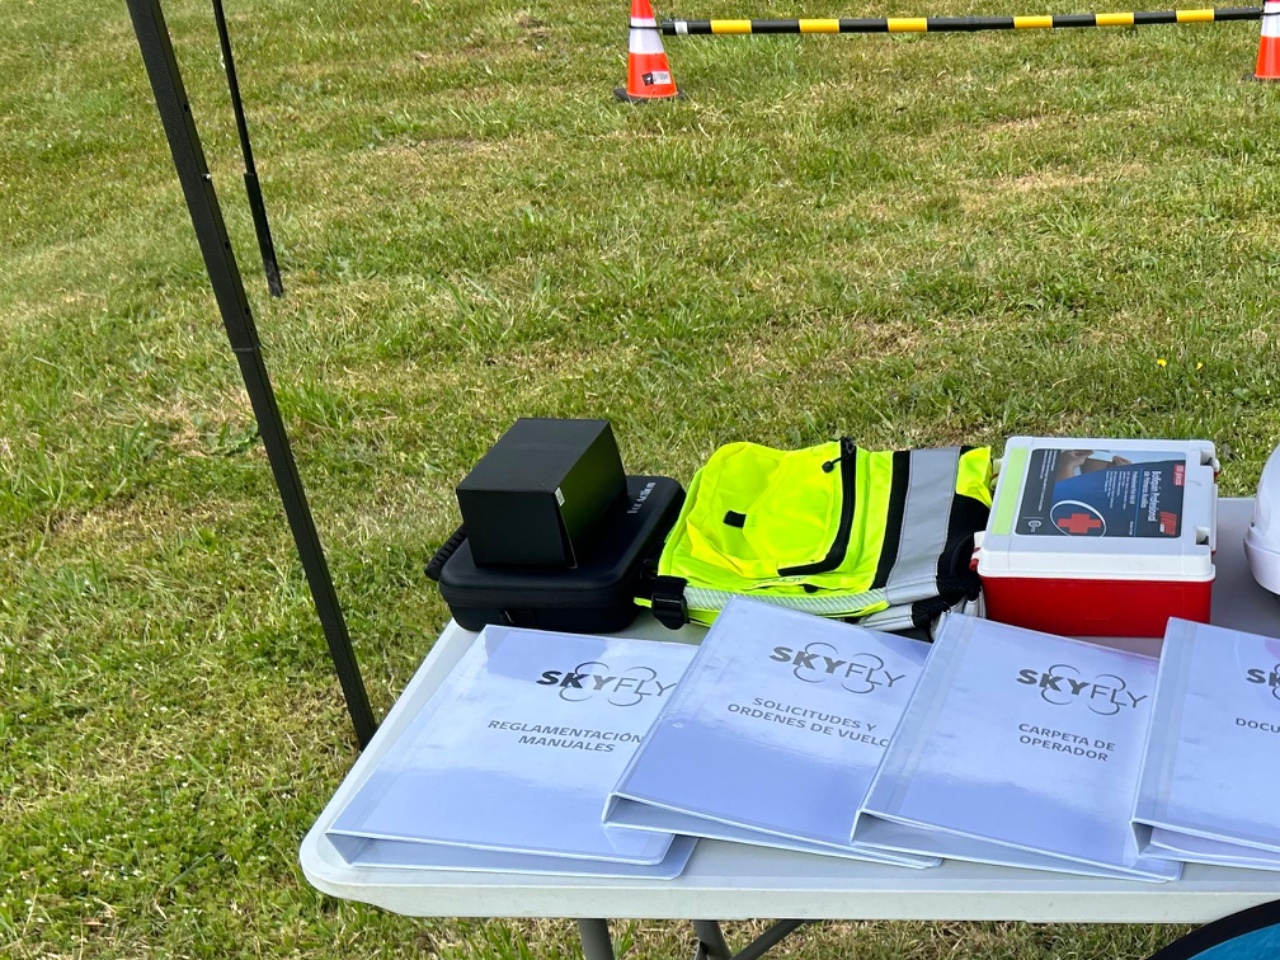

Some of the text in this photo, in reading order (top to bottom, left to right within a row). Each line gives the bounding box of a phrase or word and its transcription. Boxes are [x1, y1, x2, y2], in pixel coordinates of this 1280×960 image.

[769, 645, 906, 688] SKYFLY
[536, 669, 677, 698] SKYFLY
[1016, 668, 1148, 709] SKYFLY
[727, 703, 806, 729] ORDENES
[810, 722, 833, 736] DE
[752, 697, 878, 732] SOLICITUDES Y
[488, 719, 643, 744] REGLAMENTACIÓN
[518, 735, 616, 752] MANUALES
[1018, 723, 1116, 751] CARPETA DE
[1019, 735, 1109, 762] OPERADOR
